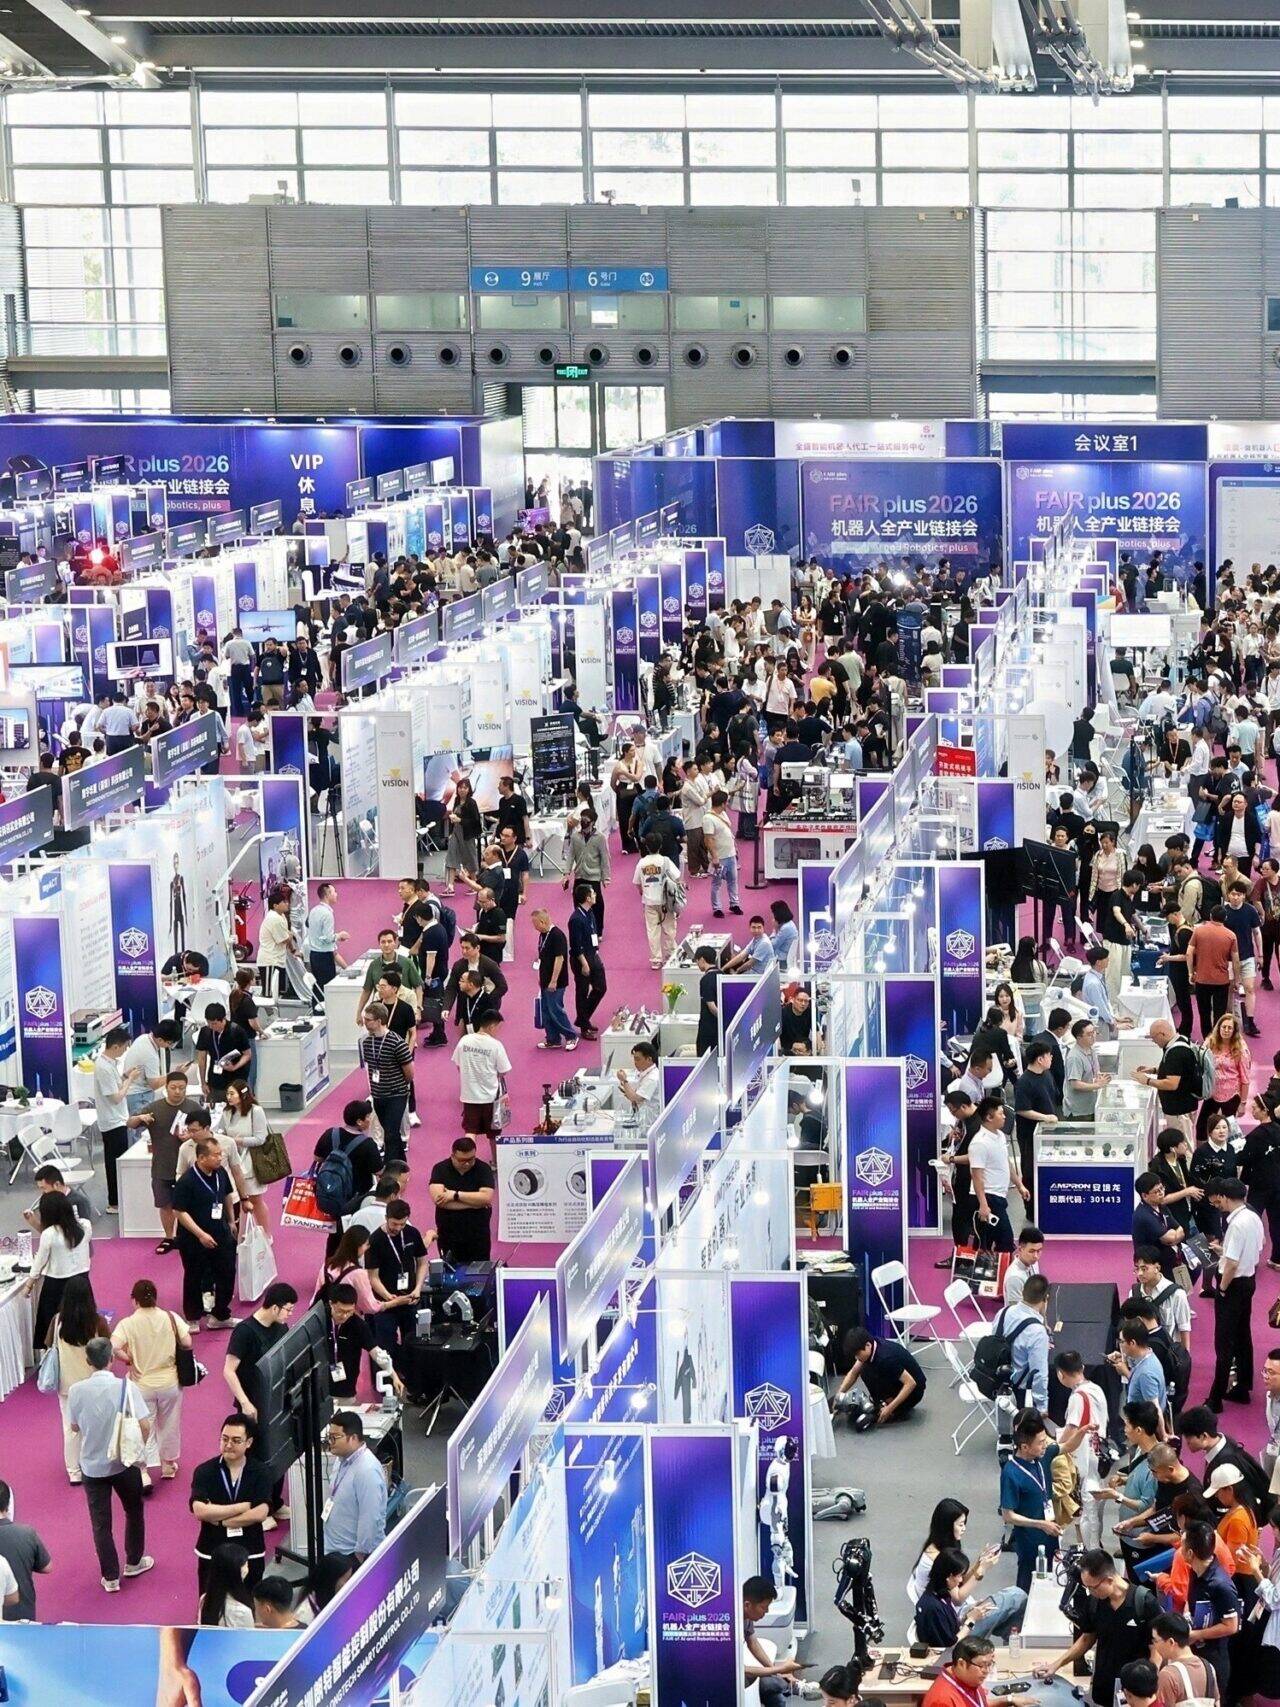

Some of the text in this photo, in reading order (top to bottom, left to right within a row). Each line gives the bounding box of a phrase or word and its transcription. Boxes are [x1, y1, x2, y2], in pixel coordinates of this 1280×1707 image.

[521, 271, 531, 286] 9
[588, 272, 597, 286] 6
[1074, 434, 1137, 452] 会议室1
[138, 454, 229, 476] plus 2026
[291, 454, 323, 469] VIP
[830, 494, 979, 518] FAIR plus 2026
[1088, 491, 1130, 514] plus
[1131, 491, 1181, 510] 2026
[831, 519, 979, 538] 机器人全产业链接会
[382, 779, 409, 787] VISION
[1092, 1183, 1121, 1193] 安培龙
[1090, 1196, 1121, 1204] 301413
[662, 1613, 730, 1624] FAIR plus 2026
[662, 1623, 731, 1631] 机器人全产业链接会
